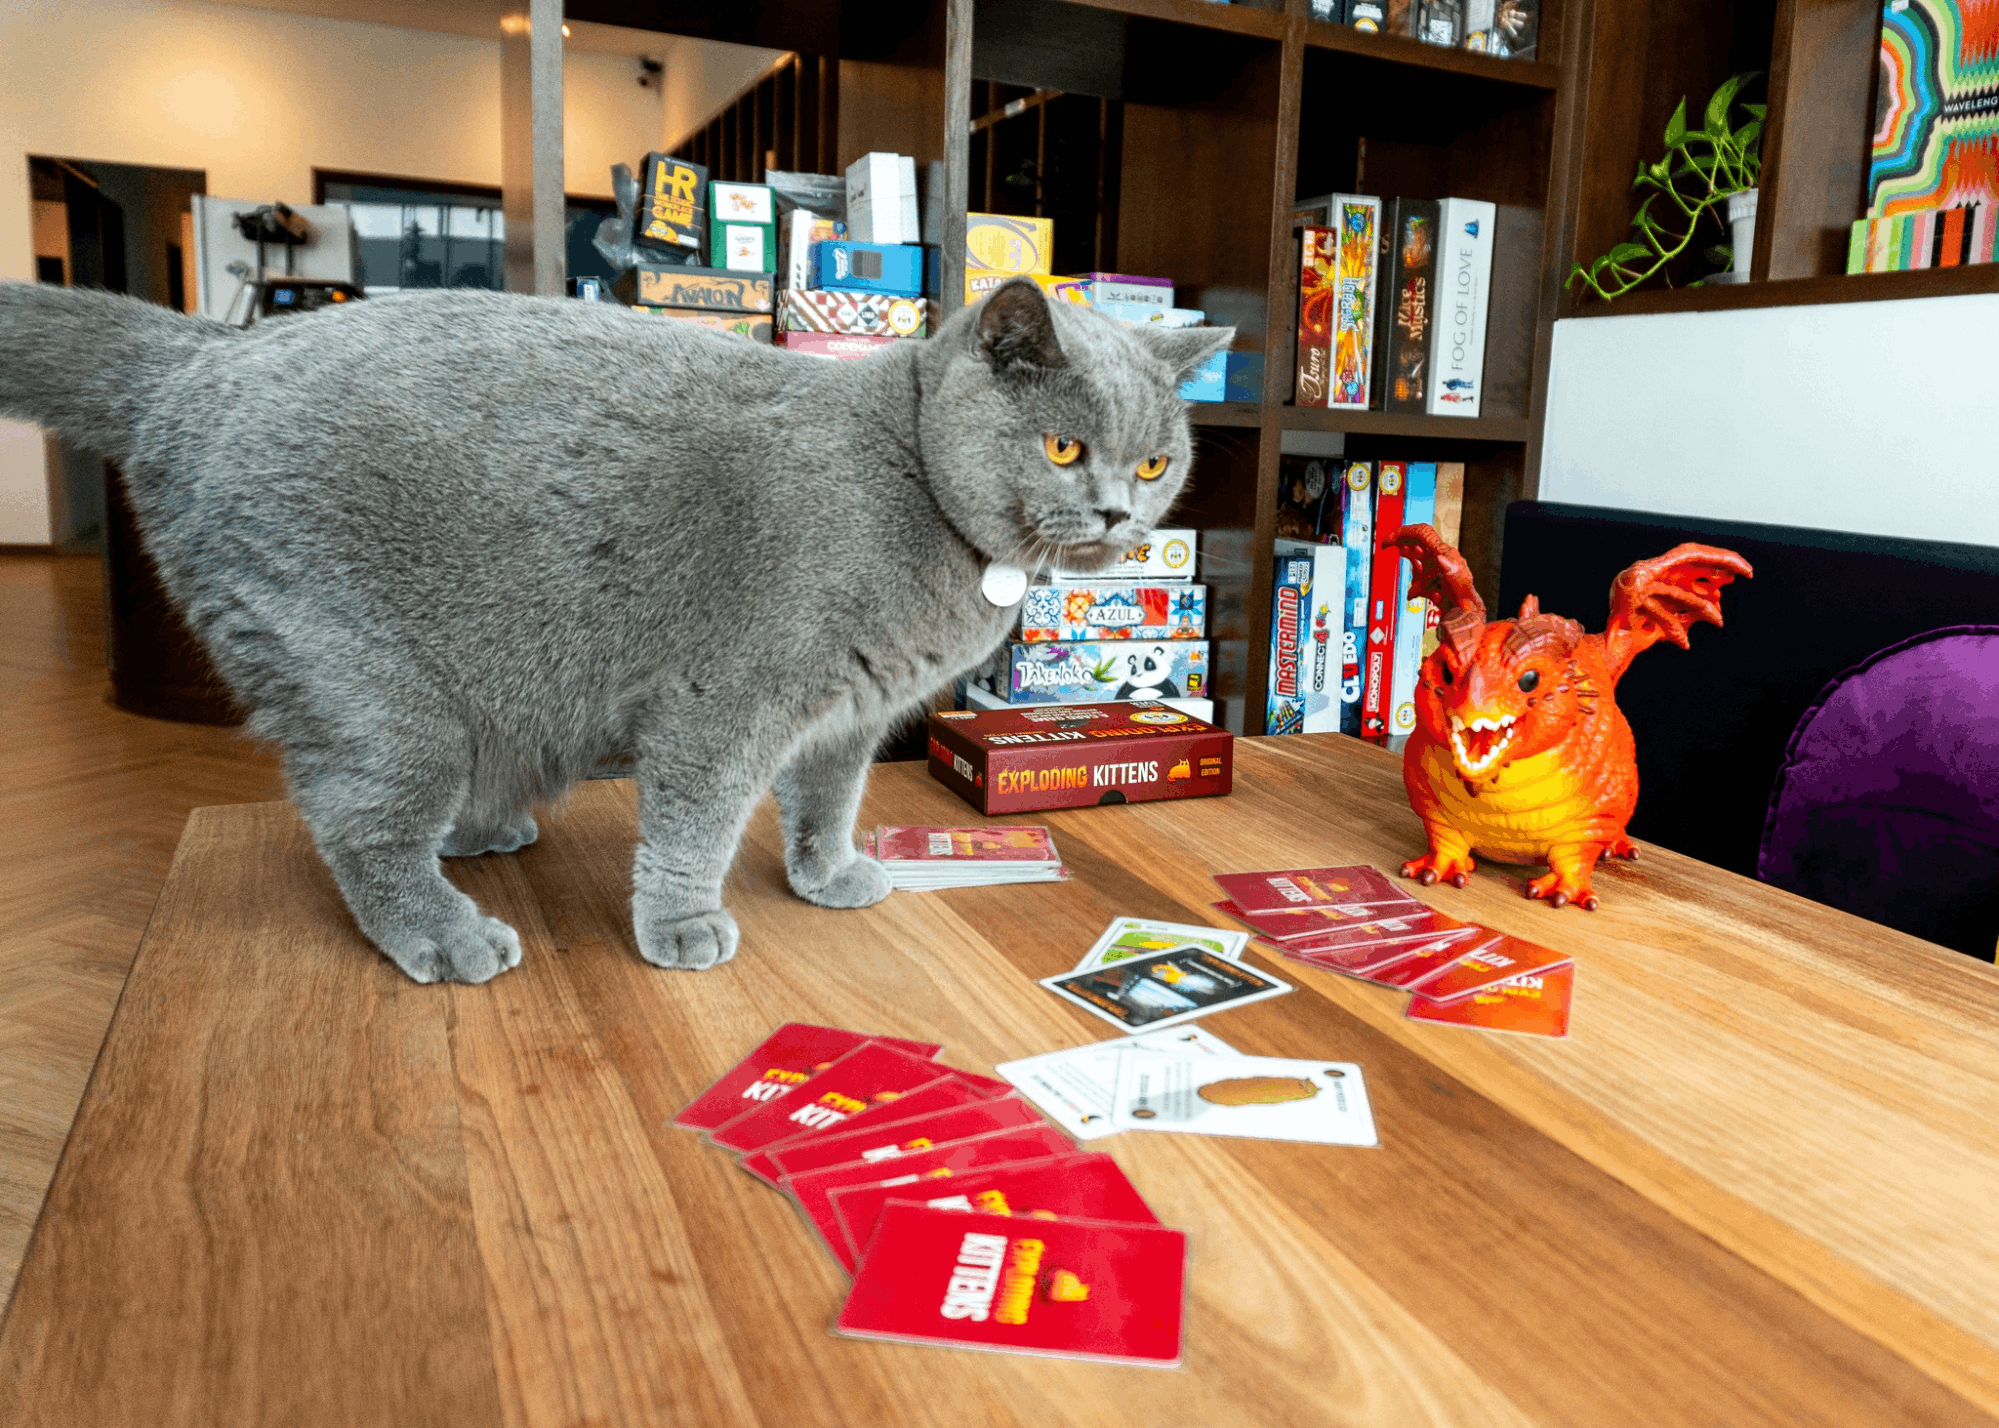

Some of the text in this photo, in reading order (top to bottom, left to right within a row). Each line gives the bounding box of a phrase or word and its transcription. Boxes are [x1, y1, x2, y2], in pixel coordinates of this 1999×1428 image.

[1944, 96, 1999, 112] WAVELENG
[655, 160, 698, 202] HR
[1456, 247, 1474, 296] LOVE
[666, 281, 744, 308] AVALON
[1454, 300, 1469, 326] OF
[1451, 332, 1466, 371] FOG
[1301, 347, 1322, 400] Tsuro
[1095, 608, 1136, 622] AZUL
[1341, 632, 1360, 703] CLUEDO
[1369, 653, 1381, 710] MONOPOLY
[988, 723, 1208, 744] EXPLODING KITTENS
[953, 753, 974, 782] KITTENS
[997, 760, 1159, 794] EXPLODING KITTENS
[1199, 757, 1222, 766] ORIGINAL
[1200, 767, 1220, 777] EDITION
[940, 1231, 1008, 1322] KITTENS
